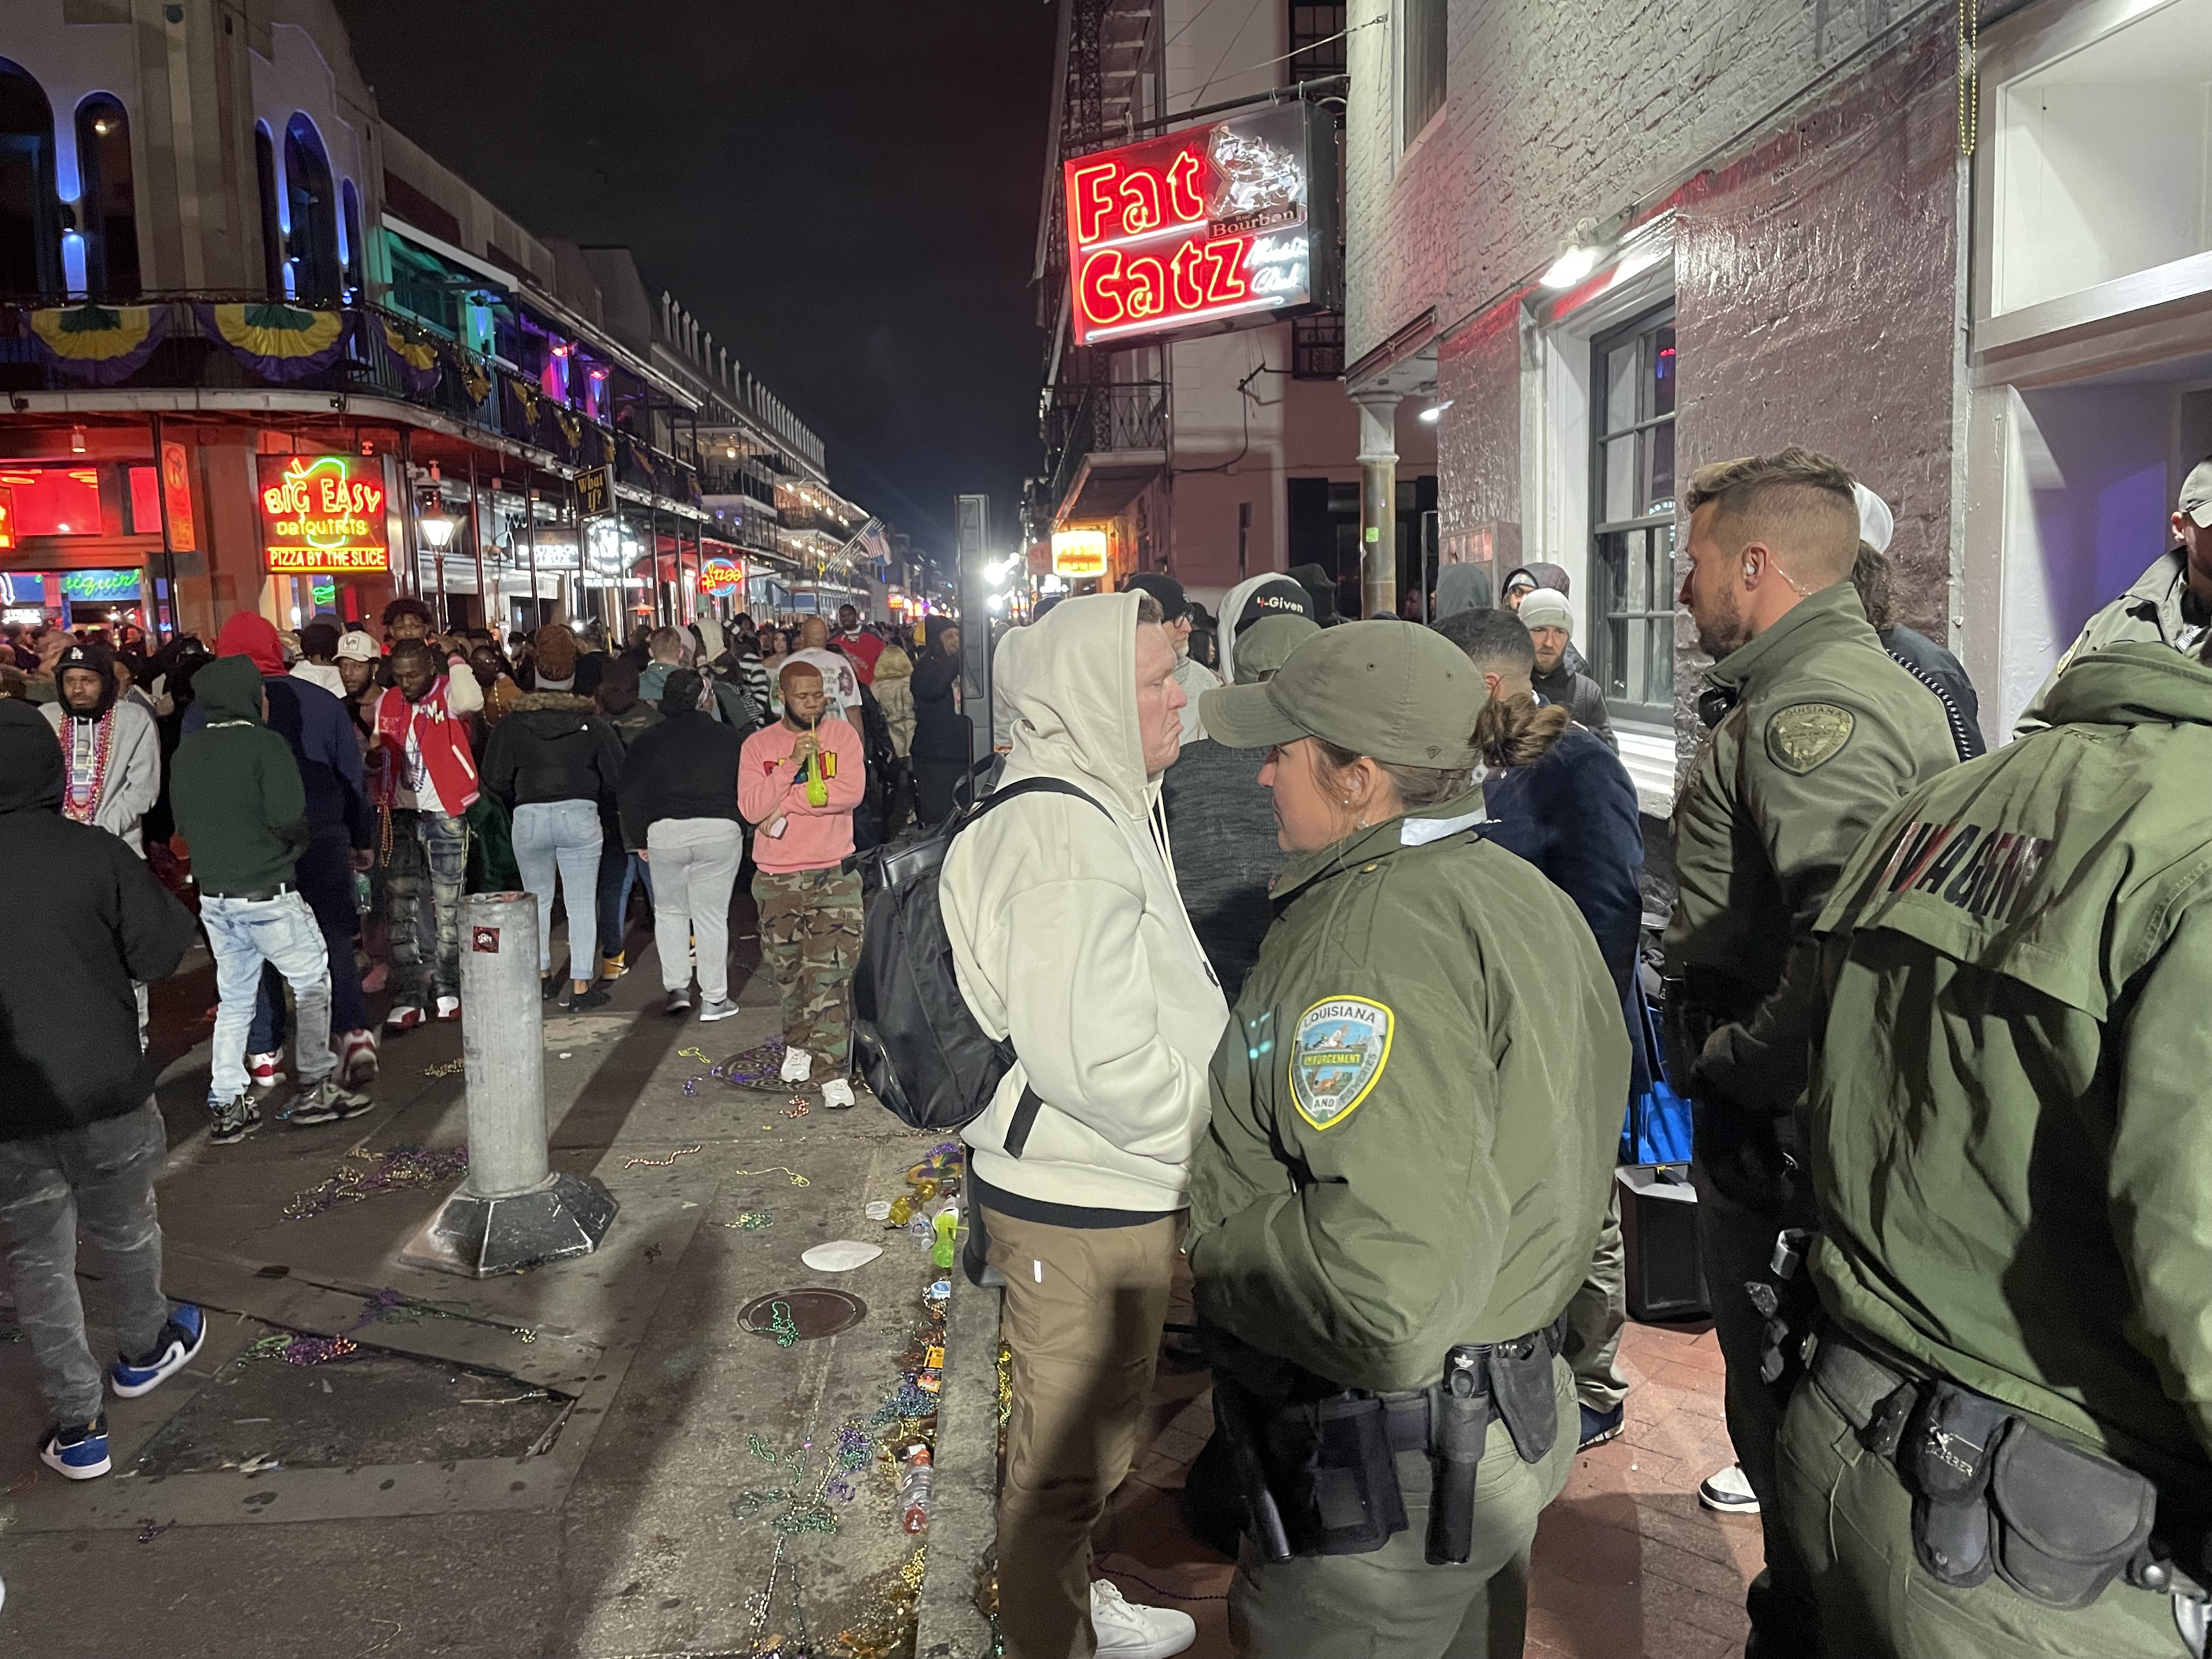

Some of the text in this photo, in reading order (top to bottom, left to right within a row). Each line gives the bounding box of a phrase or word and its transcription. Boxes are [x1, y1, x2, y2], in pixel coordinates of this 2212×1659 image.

[1074, 151, 1203, 243] Fat
[1212, 210, 1295, 237] Bourbon
[1080, 239, 1245, 323] Catz
[578, 473, 603, 493] What
[264, 478, 380, 514] BIG EASY
[270, 551, 385, 566] PIZZA BY THE SLICE
[1304, 1005, 1375, 1028] LOUISIANA
[1304, 1053, 1362, 1066] ENFORCEMENT
[1314, 1098, 1335, 1108] AND
